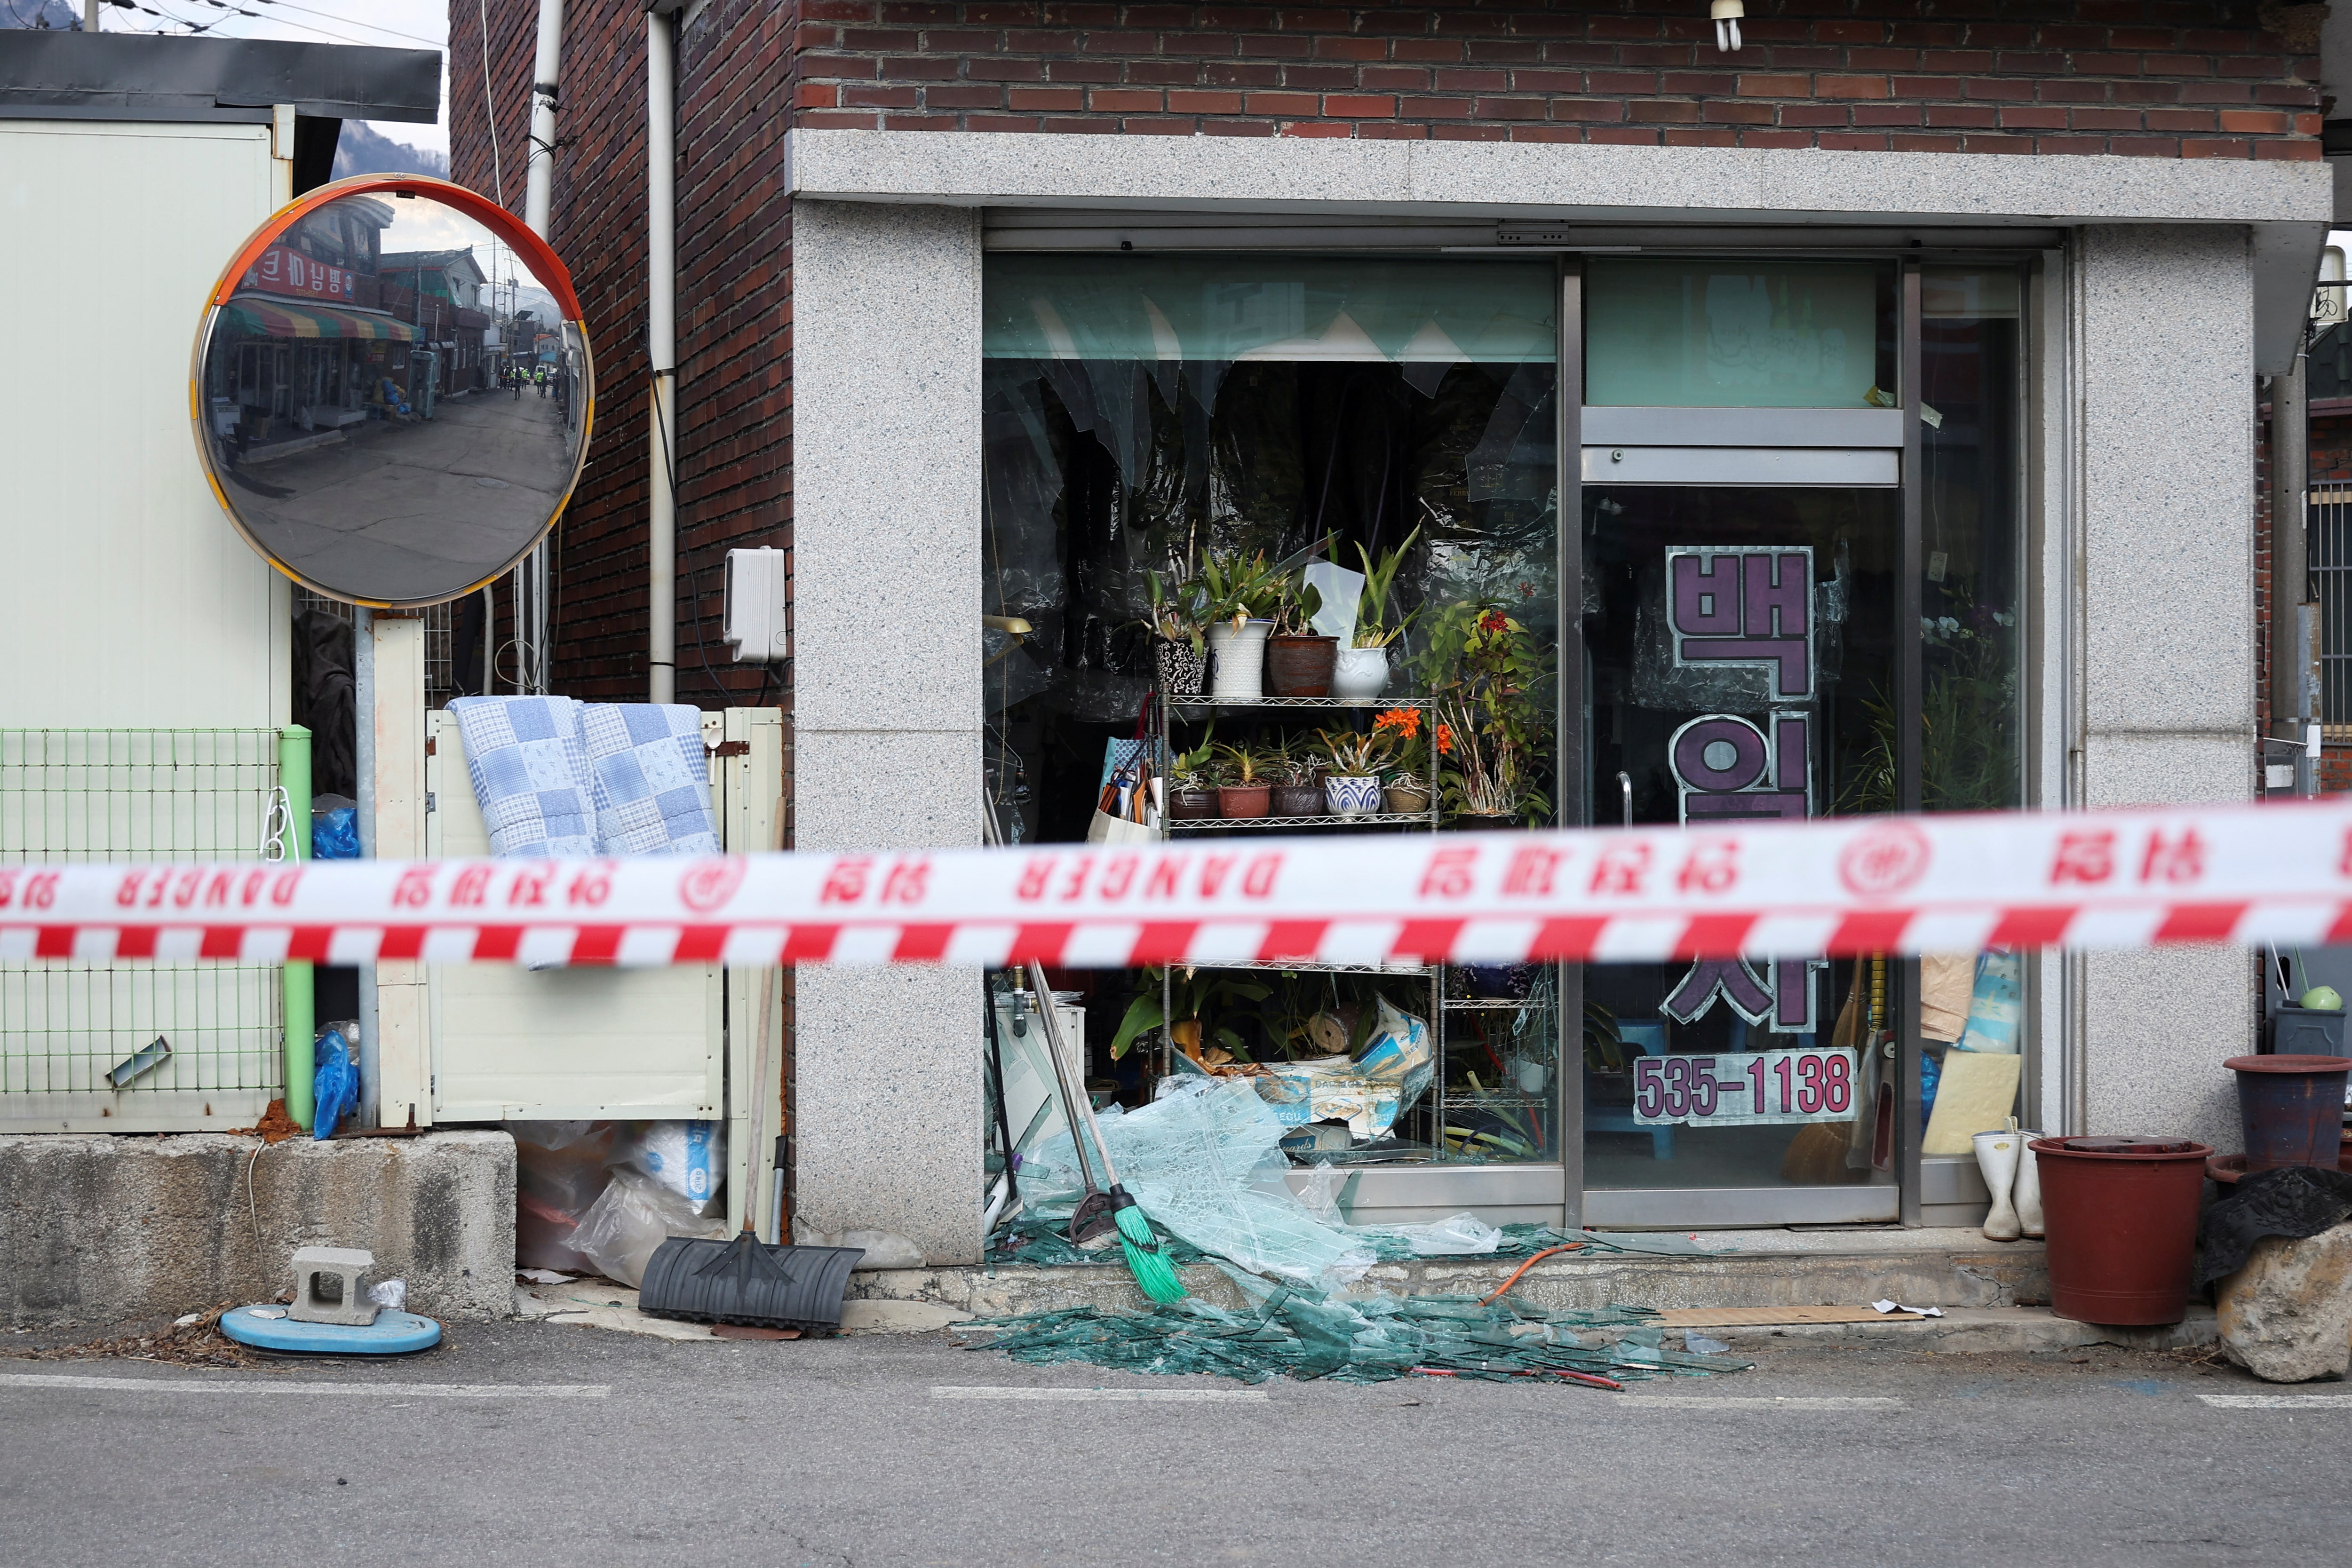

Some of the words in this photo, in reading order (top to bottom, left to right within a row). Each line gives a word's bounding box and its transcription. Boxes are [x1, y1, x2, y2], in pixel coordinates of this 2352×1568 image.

[818, 856, 931, 905] 위험
[1016, 852, 1284, 903] DANGER
[1418, 839, 1740, 899] 안전제일
[2048, 827, 2205, 887] 위험
[116, 868, 302, 908] DANGER
[392, 862, 616, 908] 안전제일
[1637, 1054, 1851, 1118] 535-1138
